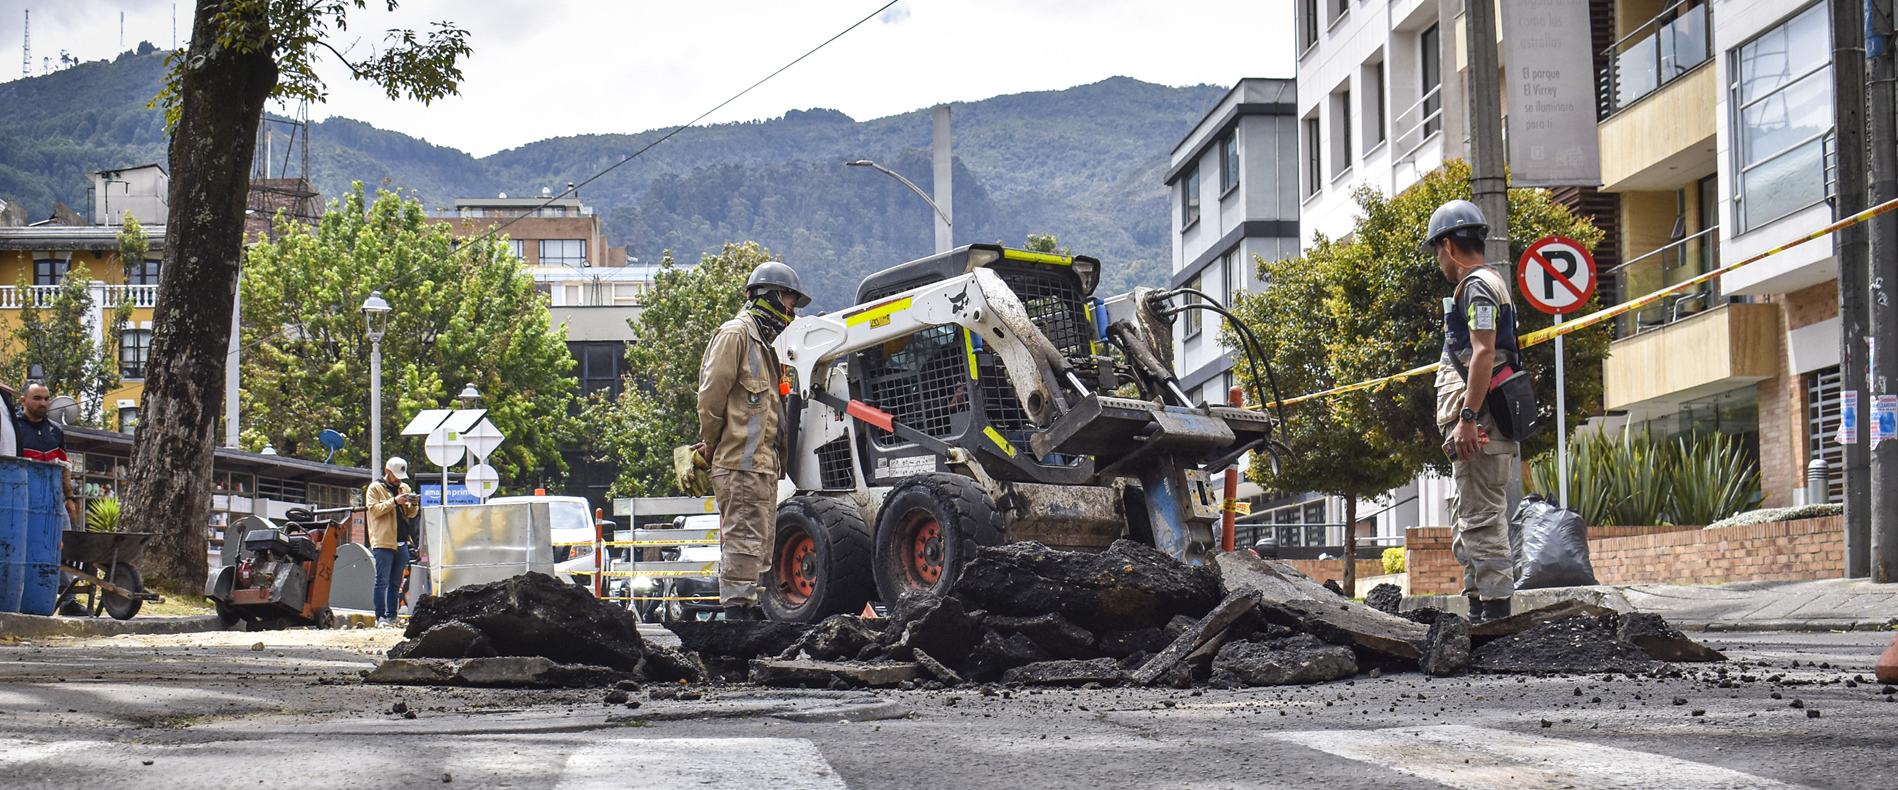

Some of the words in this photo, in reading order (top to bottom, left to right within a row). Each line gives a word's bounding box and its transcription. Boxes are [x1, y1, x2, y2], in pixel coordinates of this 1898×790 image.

[1518, 17, 1546, 27] como
[1548, 11, 1563, 27] las
[1520, 32, 1562, 48] estrellas
[1522, 67, 1529, 79] El
[1532, 69, 1560, 81] parque
[1523, 84, 1531, 96] El
[1533, 84, 1557, 97] Virrey
[1524, 103, 1533, 113] se
[1526, 120, 1545, 132] para
[1546, 119, 1553, 129] ti
[1543, 251, 1577, 300] P
[451, 488, 471, 497] prim
[319, 563, 331, 582] 25
